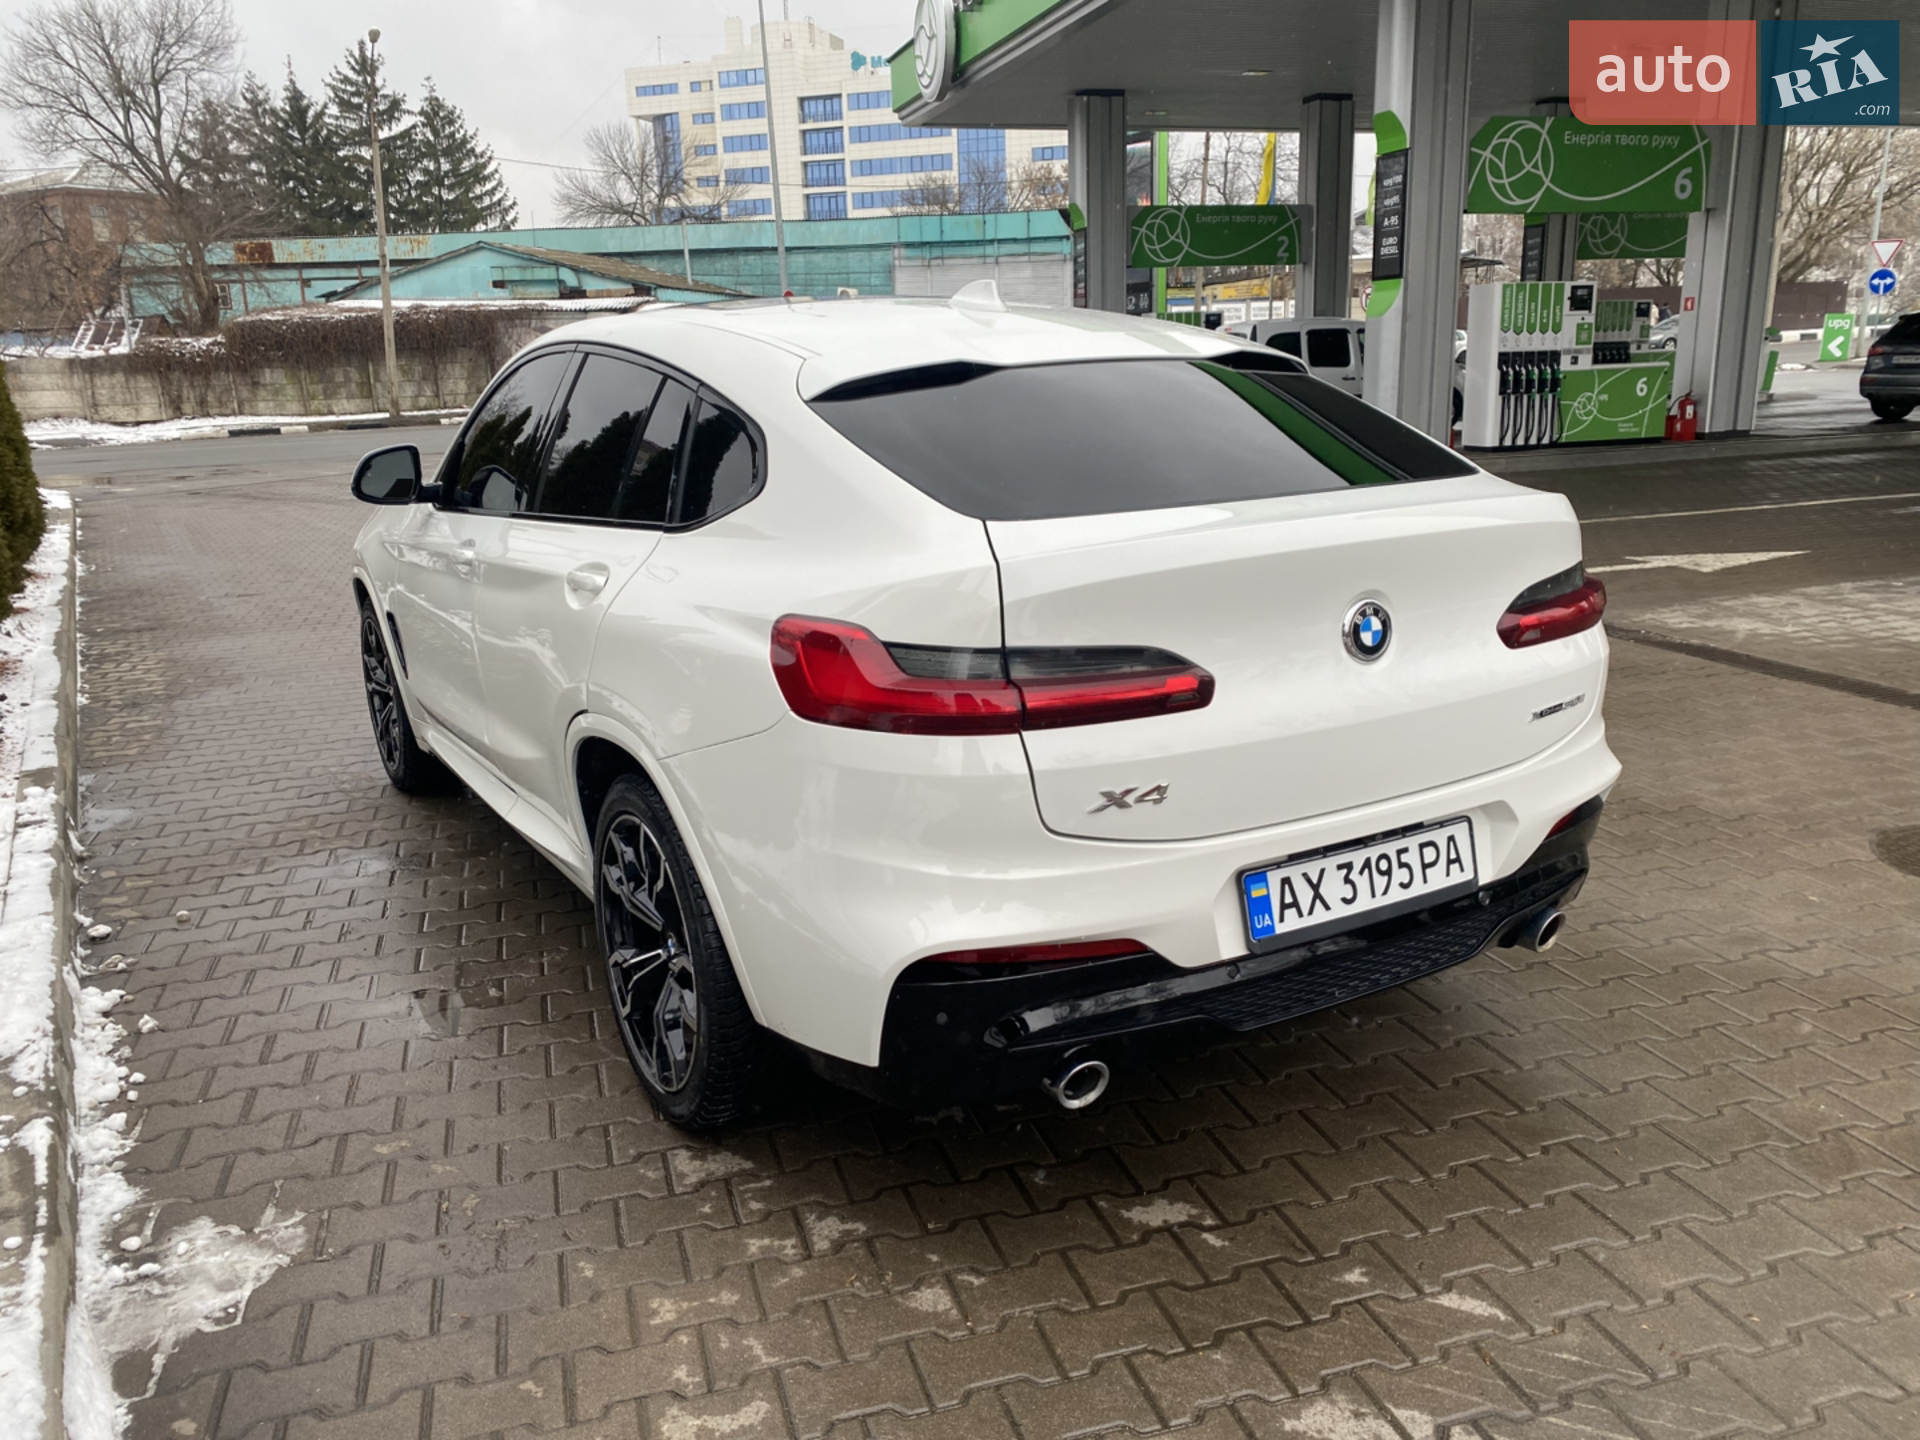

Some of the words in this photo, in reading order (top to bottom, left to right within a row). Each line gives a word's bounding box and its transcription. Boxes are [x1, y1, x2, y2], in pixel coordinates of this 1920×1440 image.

[1564, 130, 1612, 148] Енергія
[1614, 134, 1649, 146] твого
[1652, 134, 1681, 149] руху
[1674, 167, 1693, 200] 6
[1195, 213, 1230, 225] Енергія
[1231, 215, 1257, 223] твого
[1258, 215, 1278, 225] руху
[1383, 216, 1399, 227] A-95
[1277, 235, 1290, 257] 2
[1382, 236, 1398, 246] EURO
[1380, 246, 1399, 256] DIESEL
[1828, 319, 1851, 330] upg
[1636, 377, 1648, 397] 6
[1355, 606, 1386, 625] BMW
[1087, 782, 1170, 815] X4
[1278, 867, 1331, 924] AX
[1336, 846, 1414, 906] 3195
[1418, 834, 1465, 885] PA
[1254, 913, 1272, 929] UA
